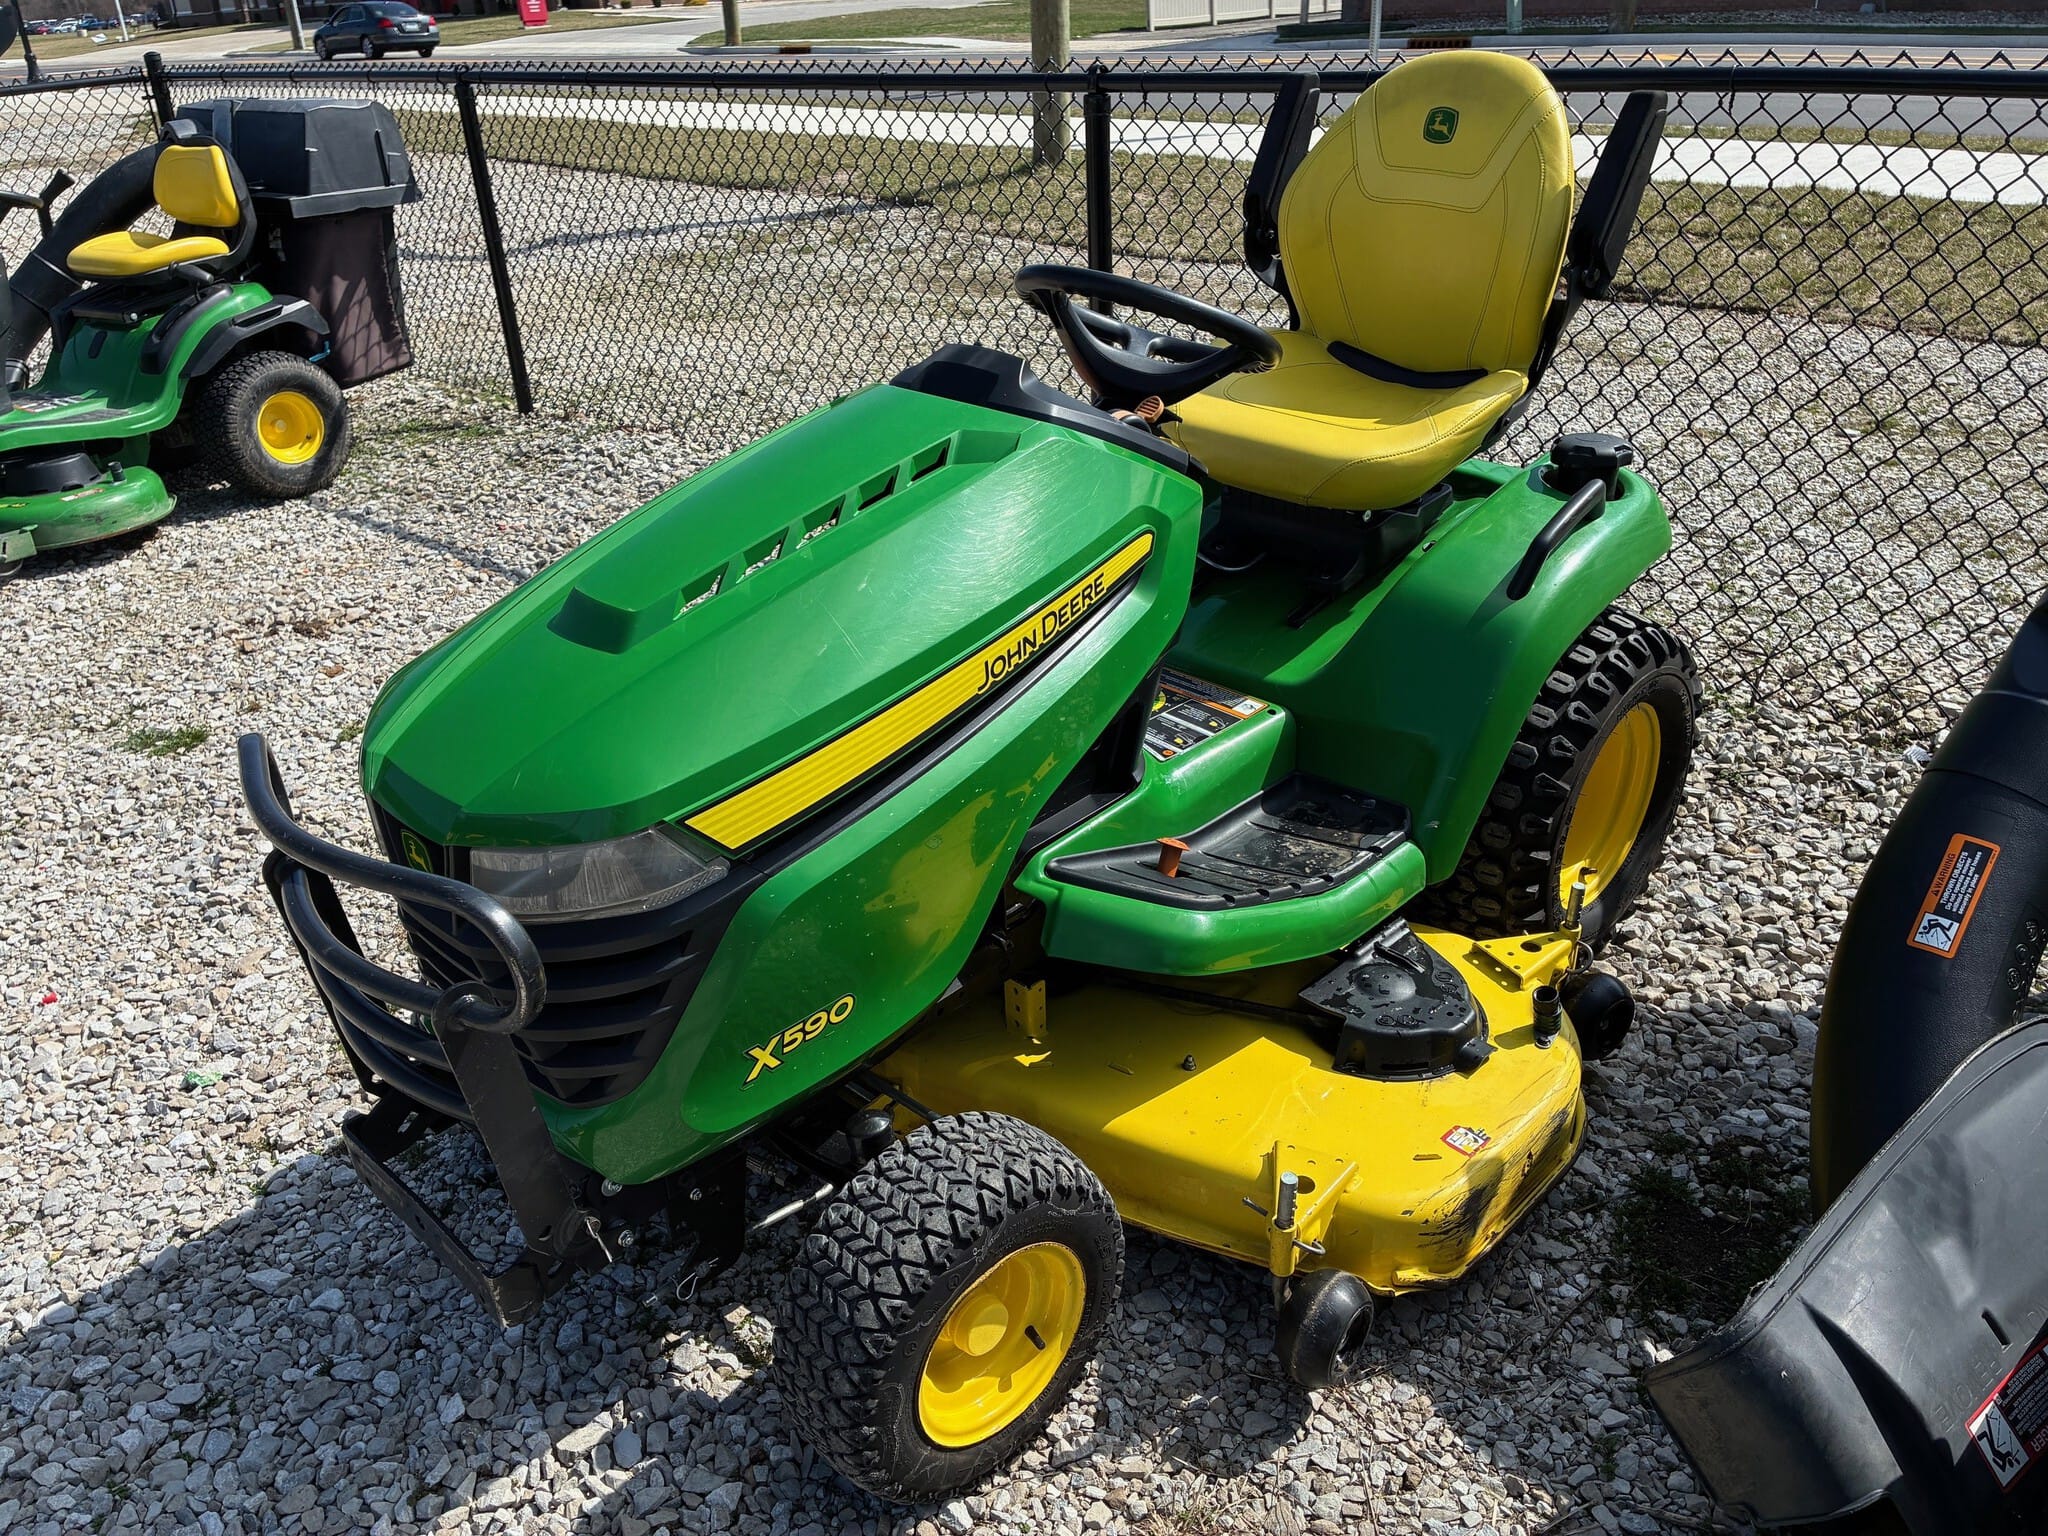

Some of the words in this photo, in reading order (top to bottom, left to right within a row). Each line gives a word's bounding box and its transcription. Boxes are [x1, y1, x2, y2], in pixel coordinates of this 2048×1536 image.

[978, 630, 1038, 692] JOHN
[1041, 573, 1106, 642] DEERE
[1934, 852, 1956, 889] WARNING
[1940, 878, 1957, 905] THROWN
[1952, 850, 1969, 879] OBJECTS
[744, 994, 855, 1085] X590
